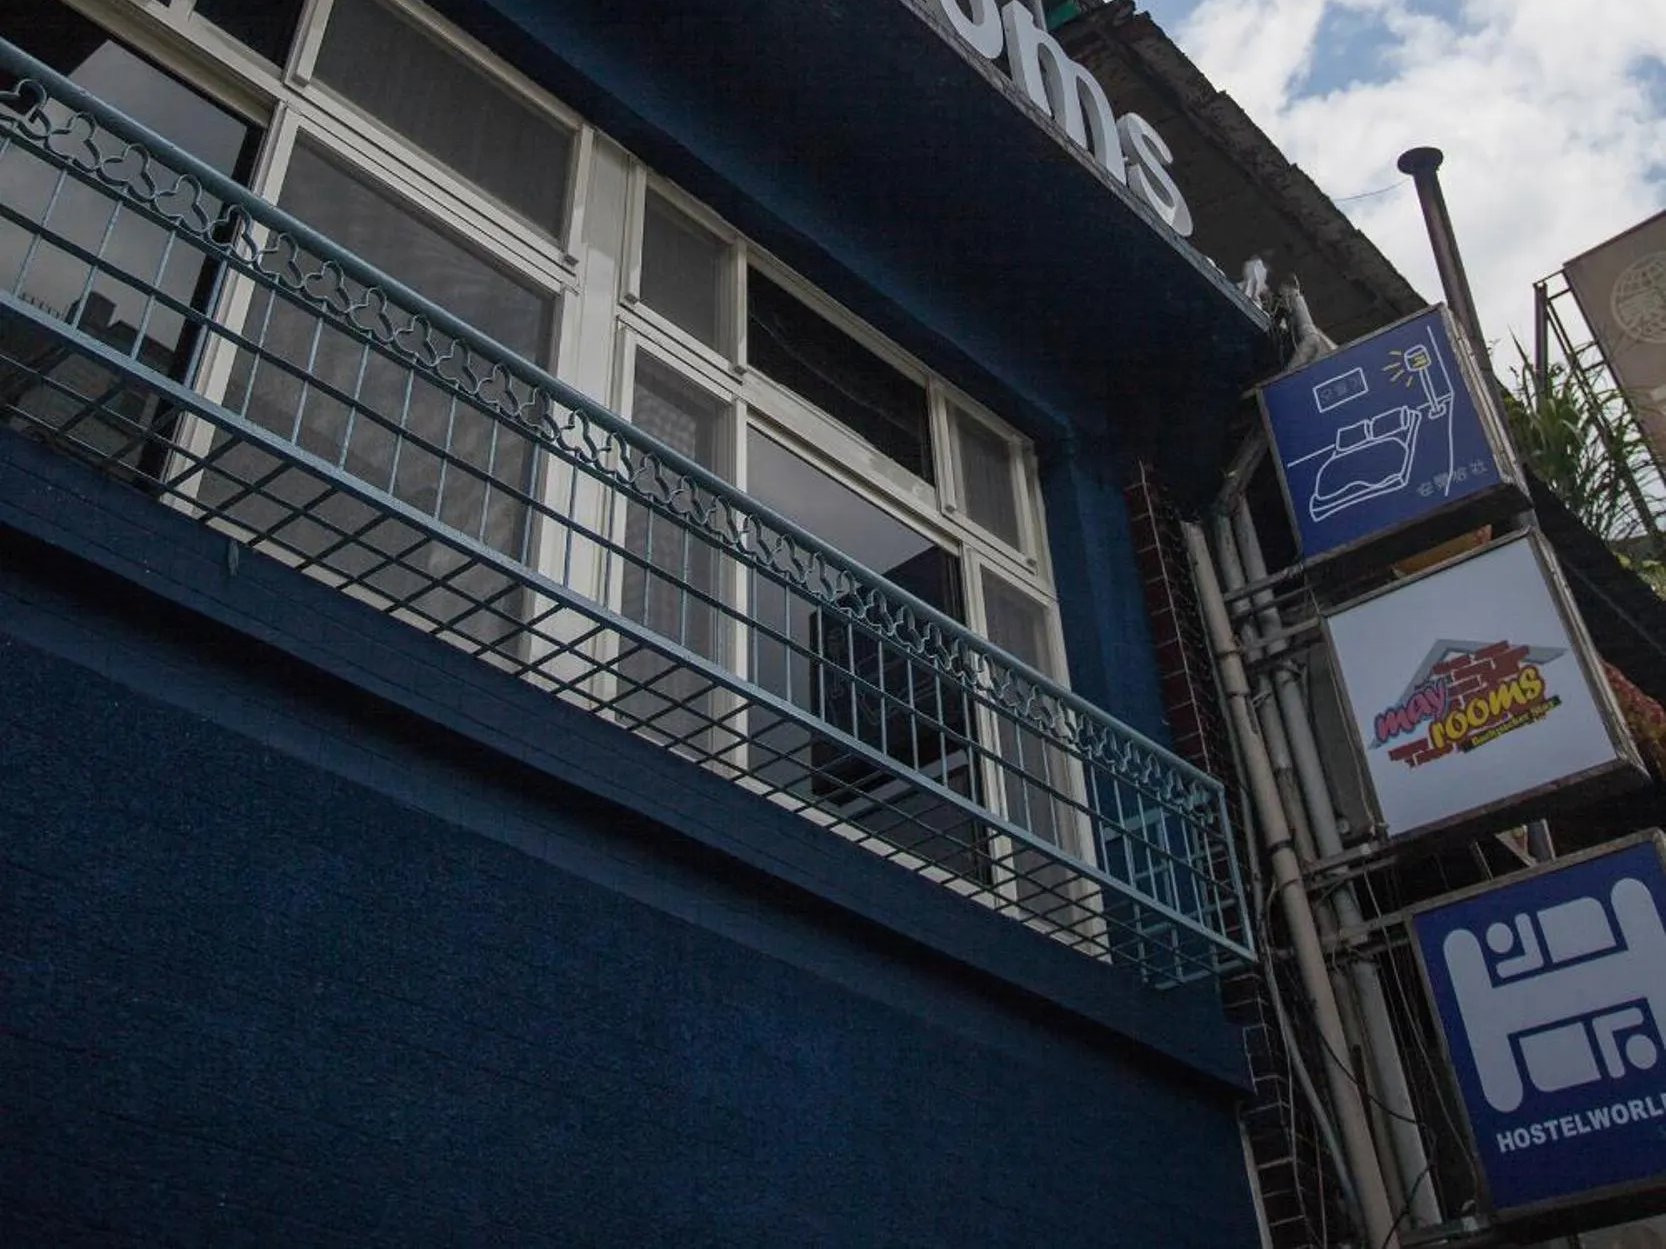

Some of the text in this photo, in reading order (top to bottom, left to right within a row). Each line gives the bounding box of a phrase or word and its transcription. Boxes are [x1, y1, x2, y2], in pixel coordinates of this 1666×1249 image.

[1374, 679, 1448, 743] may
[1428, 664, 1545, 750] rooms
[1496, 1093, 1666, 1153] HOSTELWORL
